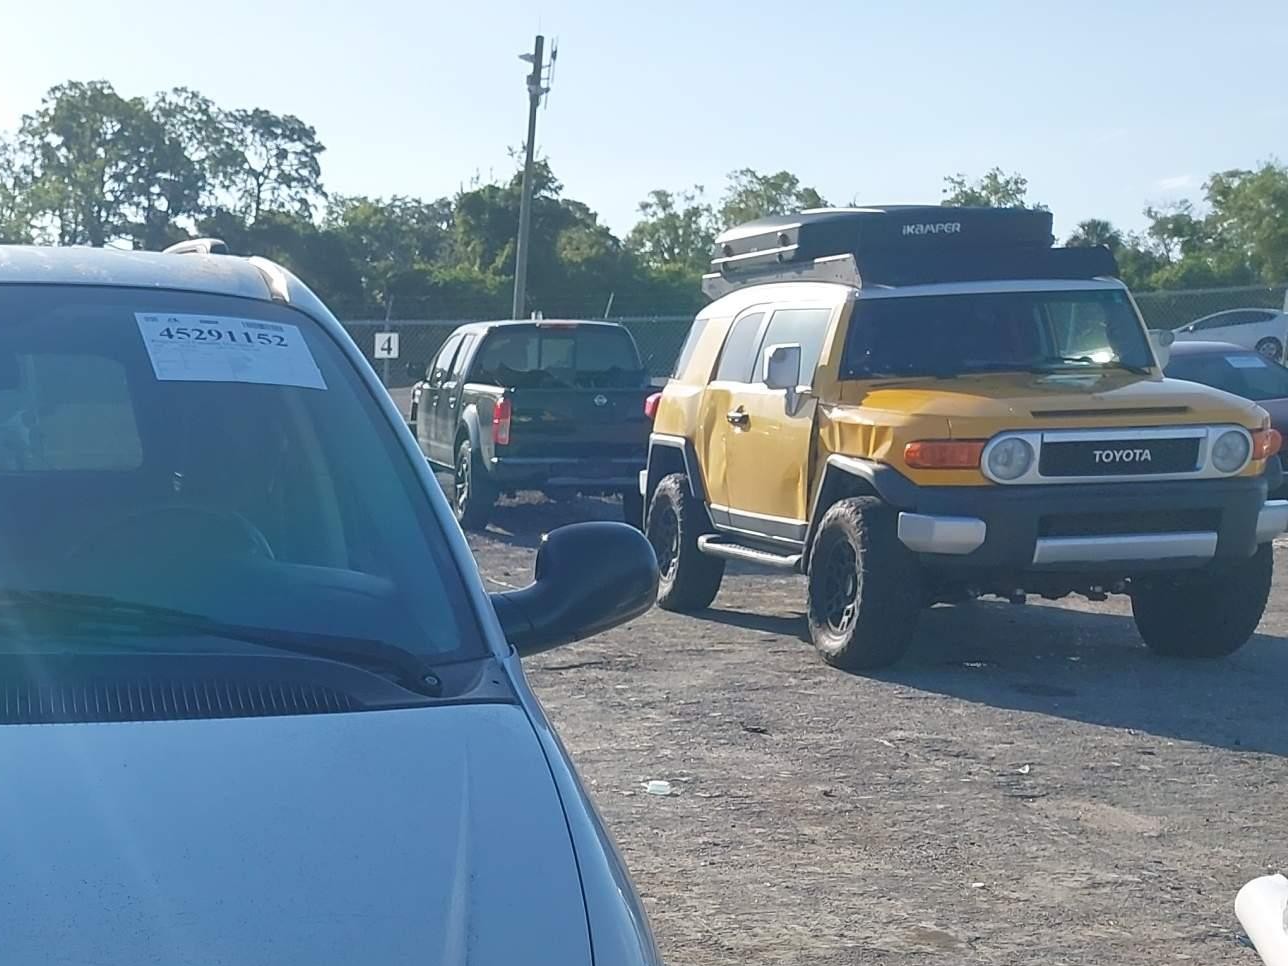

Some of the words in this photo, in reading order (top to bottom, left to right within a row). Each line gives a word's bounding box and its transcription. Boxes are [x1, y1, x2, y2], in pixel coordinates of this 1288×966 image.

[159, 327, 289, 348] 45291152
[380, 335, 393, 355] 4
[1093, 449, 1152, 462] TOYOTA
